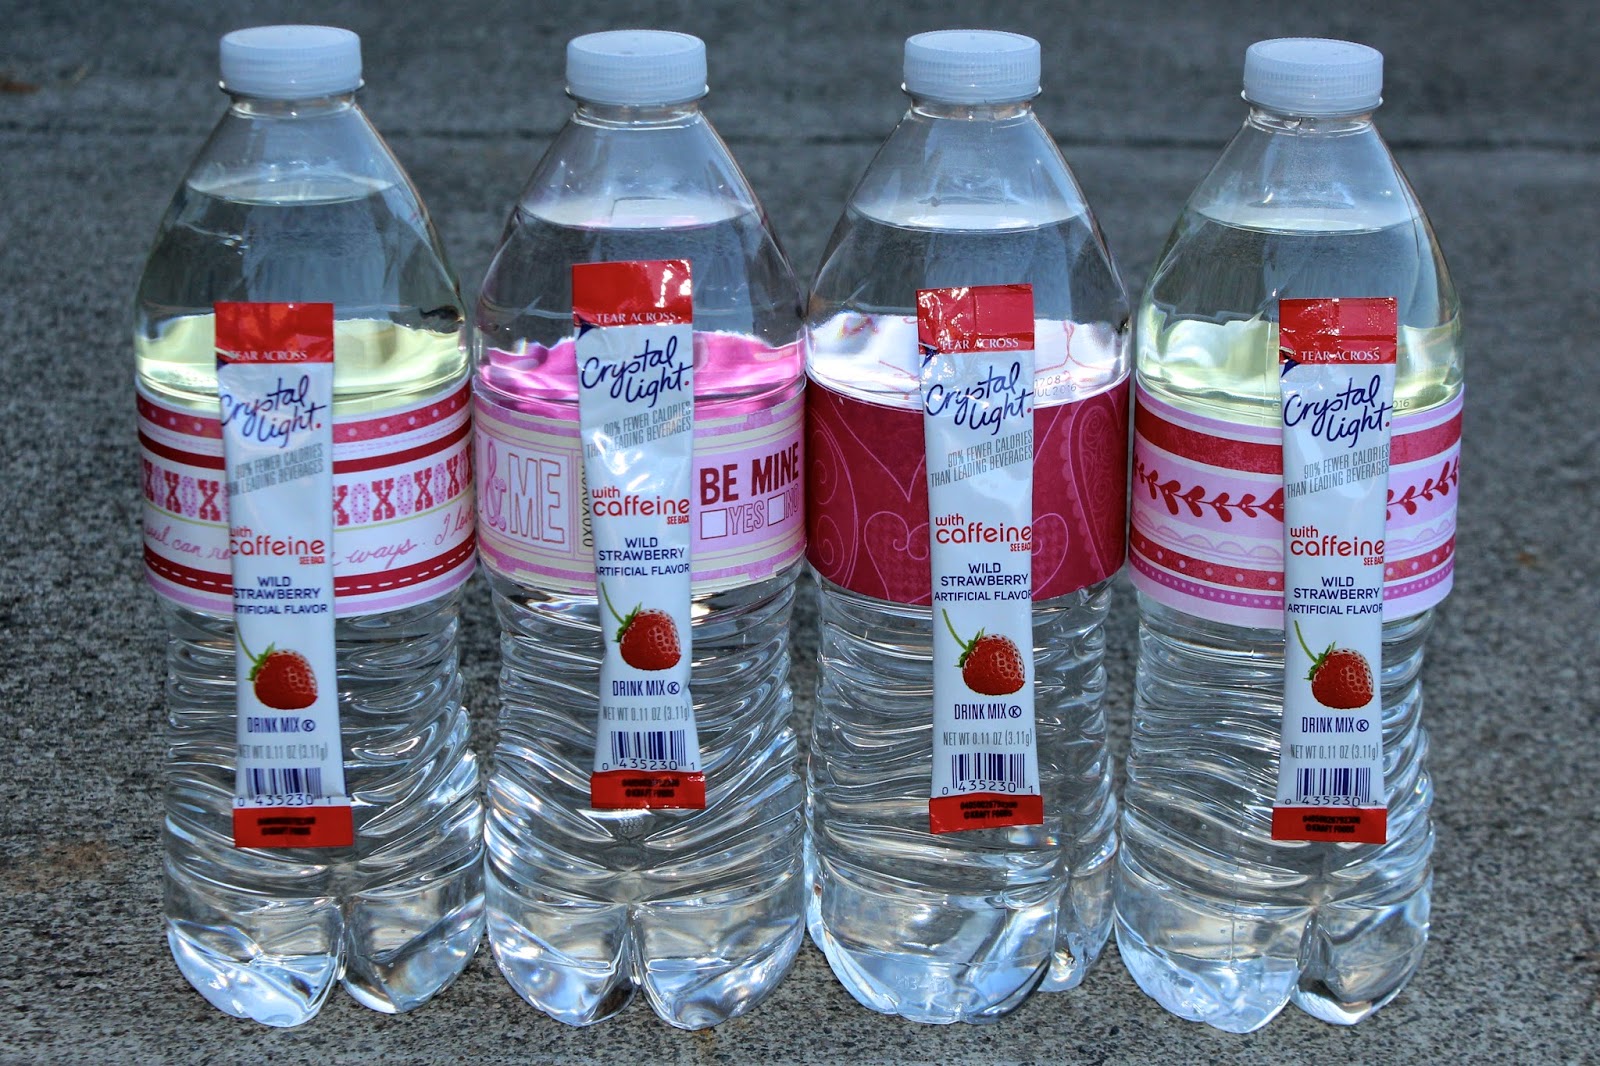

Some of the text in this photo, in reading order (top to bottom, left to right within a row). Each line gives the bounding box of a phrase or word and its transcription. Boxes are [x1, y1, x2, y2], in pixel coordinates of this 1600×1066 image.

[596, 312, 676, 324] TEAR ACROSS
[973, 337, 1019, 349] ACROSS
[263, 350, 308, 361] ACROSS
[1301, 350, 1380, 361] TEAR ACROSS
[581, 335, 678, 399] Crystal
[926, 361, 1020, 426] Crystal
[220, 374, 309, 437] Crystal
[1283, 374, 1381, 437] Crystal
[623, 412, 649, 433] FEWER
[652, 401, 692, 425] CALORIES
[646, 416, 692, 442] BEVERAGES
[948, 429, 1033, 468] 90% FEWER CALORIES
[254, 454, 281, 473] FEWER
[283, 443, 323, 466] CALORIES
[1304, 443, 1389, 480] 90% FEWER CALORIES
[700, 441, 799, 506] BE MINE
[930, 444, 1033, 488] THAN LEADING BEVERAGES
[241, 470, 276, 494] LEADING
[278, 458, 324, 483] BEVERAGES
[1287, 458, 1389, 499] THAN LEADING BEVERAGES
[591, 485, 620, 498] with
[592, 495, 690, 517] caffeine
[666, 516, 677, 525] SEE
[729, 500, 765, 536] YES
[935, 513, 964, 526] with
[935, 522, 1032, 544] caffeine
[1290, 525, 1319, 538] with
[230, 535, 325, 556] caffeine
[625, 537, 658, 548] WILD
[1010, 543, 1021, 552] SEE
[1290, 535, 1385, 556] caffeine
[598, 547, 685, 561] STRAWBERRY
[1363, 557, 1373, 566] SEE
[651, 563, 690, 576] FLAVOR
[968, 562, 1001, 574] WILD
[257, 576, 291, 587] WILD
[940, 573, 1029, 587] STRAWBERRY
[1321, 576, 1354, 587] WILD
[233, 587, 321, 600] STRAWBERRY
[934, 591, 991, 601] ARTIFICIAL
[1293, 587, 1380, 600] STRAWBERRY
[284, 603, 328, 614] FLAVOR
[1287, 602, 1382, 615] ARTIFICIAL FLAVOR
[612, 680, 644, 697] DRINK
[646, 680, 666, 696] MIX
[602, 706, 615, 720] NET
[617, 707, 629, 721] WT
[631, 707, 648, 721] 0.11
[651, 707, 662, 721] OZ
[954, 703, 985, 720] DRINK
[988, 703, 1007, 719] MIX
[247, 717, 278, 733] DRINK
[280, 717, 300, 733] MIX
[1302, 716, 1333, 733] DRINK
[1335, 716, 1355, 733] MIX
[943, 728, 1033, 747] NET WT 0.11 OZ (3.11g)
[1290, 742, 1379, 760] NET WT 0.11 OZ (3.11g)
[602, 758, 695, 771] 0 435230 1
[942, 780, 1033, 795] 0 435230 1
[255, 793, 314, 806] 435230
[1301, 796, 1360, 808] 435230
